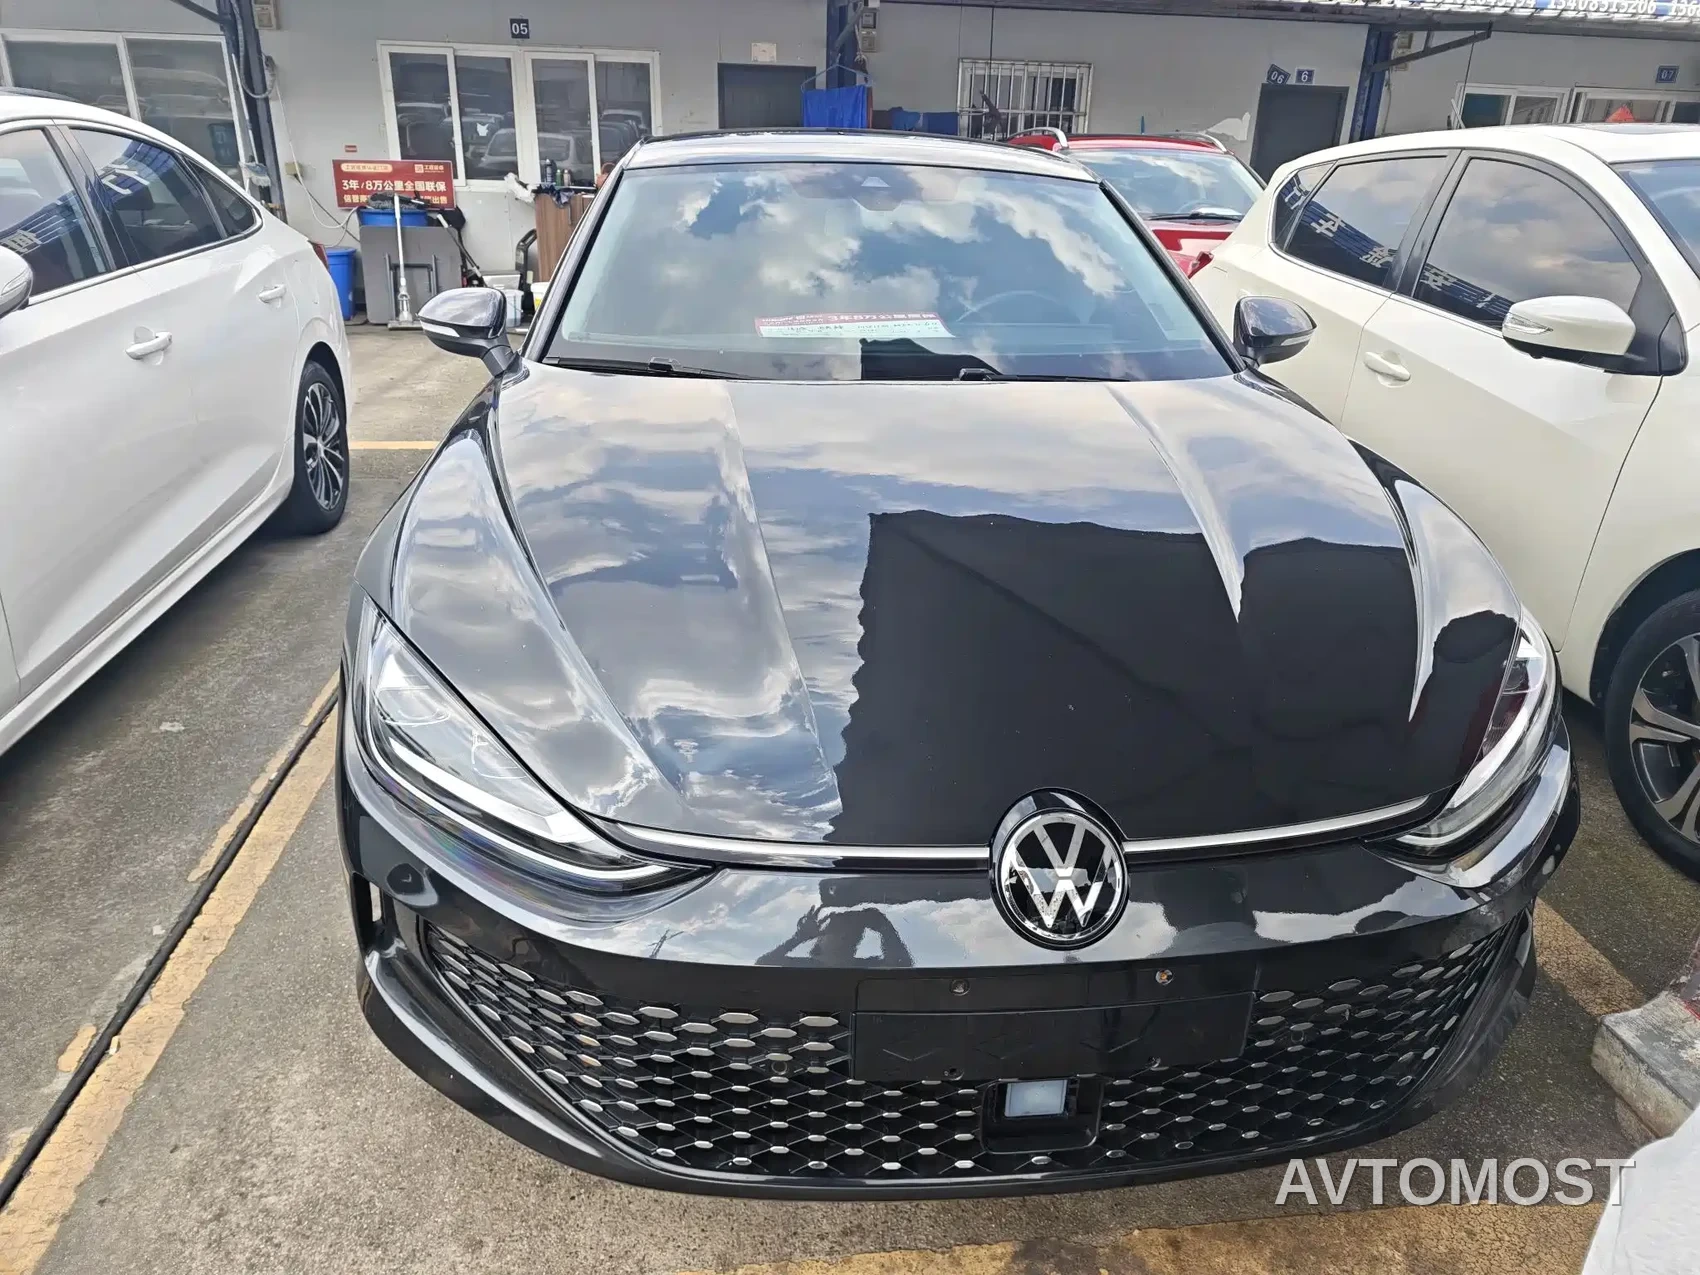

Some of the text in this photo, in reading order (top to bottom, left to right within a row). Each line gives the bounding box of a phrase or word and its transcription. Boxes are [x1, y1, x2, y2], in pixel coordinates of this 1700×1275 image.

[511, 22, 528, 35] 05
[1270, 70, 1285, 84] 06
[1301, 70, 1309, 82] 6
[1661, 69, 1674, 80] 07
[1003, 812, 1122, 939] VW
